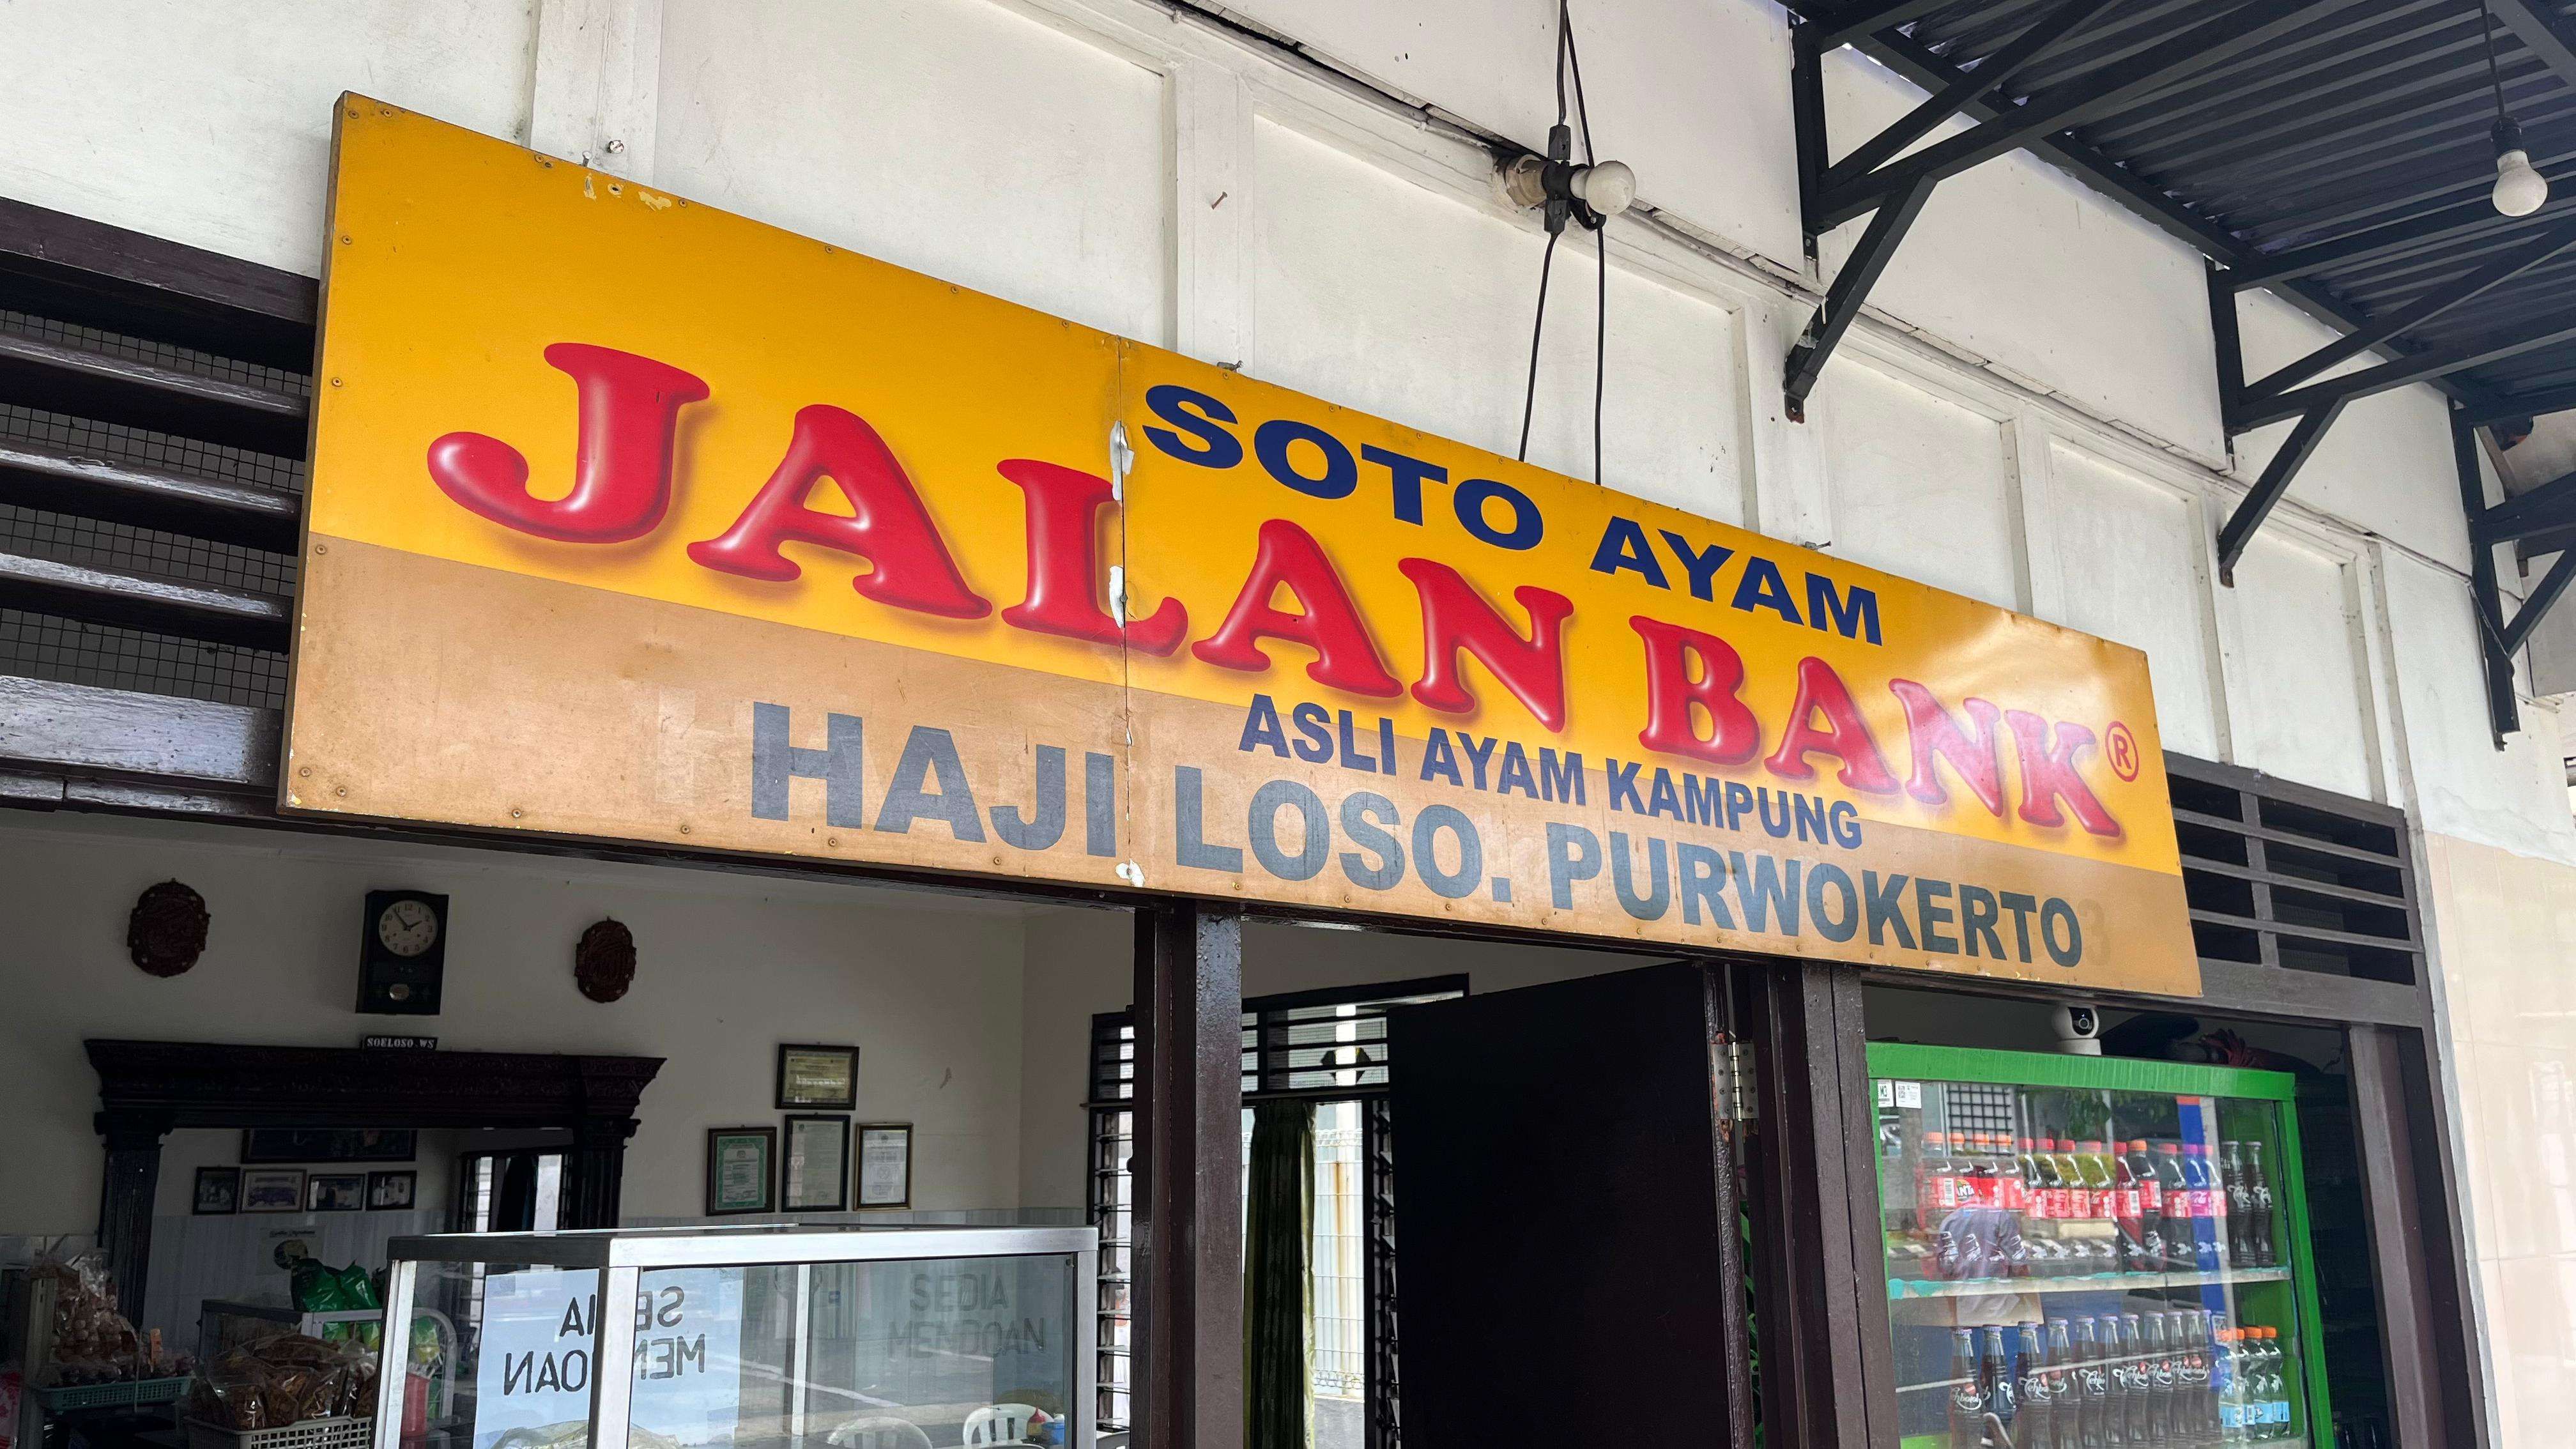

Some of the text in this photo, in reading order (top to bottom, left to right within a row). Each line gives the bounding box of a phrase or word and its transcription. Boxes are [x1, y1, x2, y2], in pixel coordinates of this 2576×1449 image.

[427, 342, 1574, 733] JALAN
[1629, 615, 2123, 838] BANK
[1143, 385, 1882, 647] SOTO AYAM
[751, 702, 1116, 857] HAJI
[1175, 765, 1511, 902] LOSO.
[1546, 822, 2081, 967] PURWOKERTO
[1239, 693, 1862, 848] ASLI AYAM KAMPUNG
[910, 1274, 1008, 1311] SEDIA
